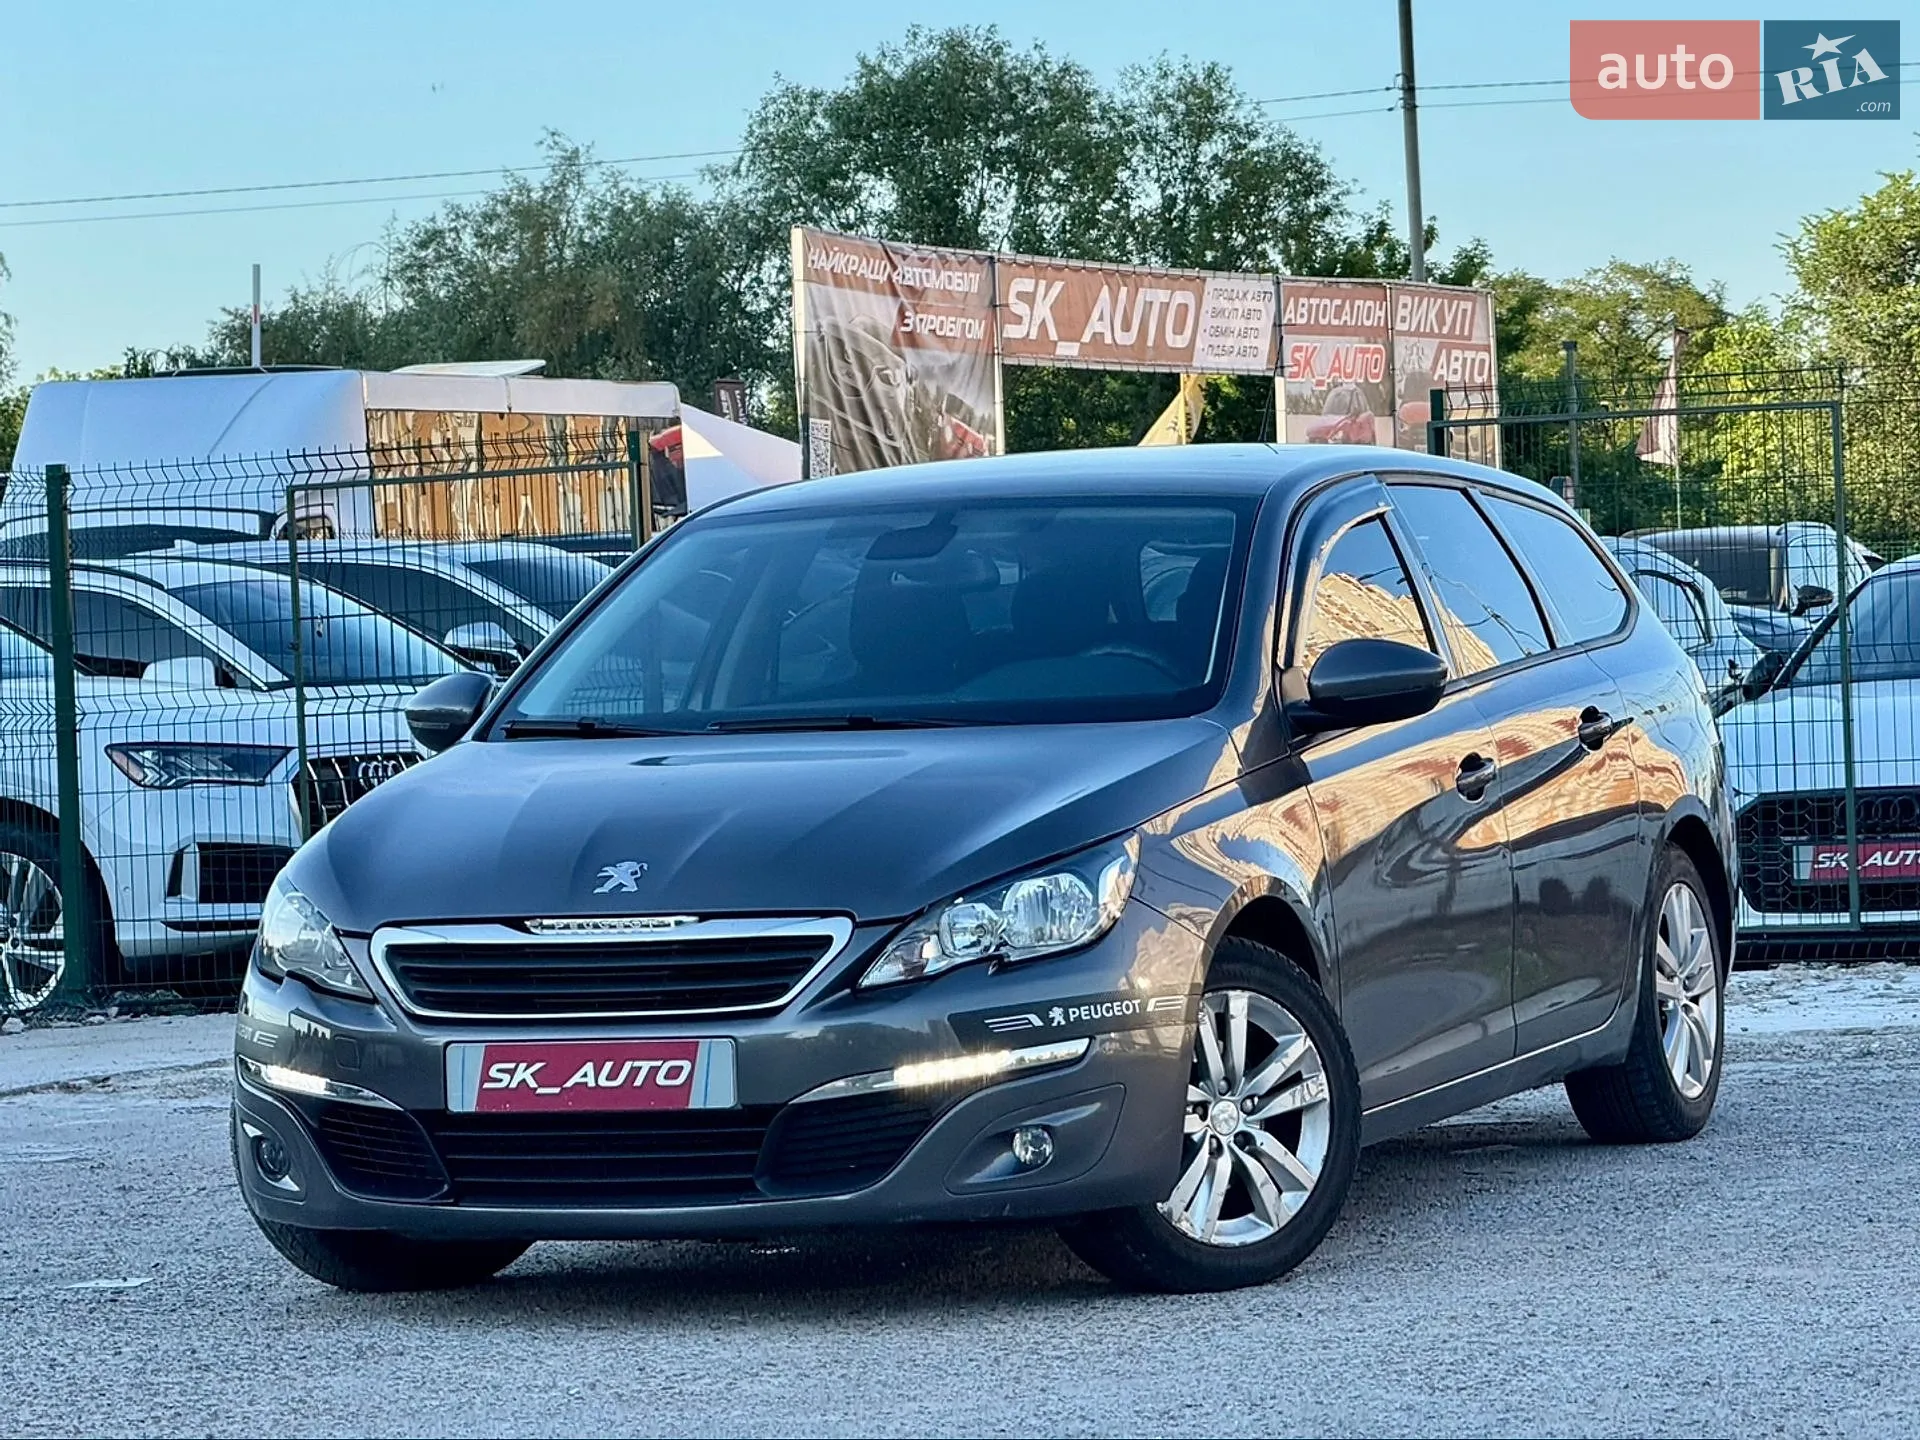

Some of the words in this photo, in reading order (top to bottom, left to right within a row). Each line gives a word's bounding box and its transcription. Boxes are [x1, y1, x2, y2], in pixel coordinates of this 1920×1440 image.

[807, 246, 890, 284] НАЙКРАЩІ
[892, 265, 980, 294] АВТОМОБІЛІ
[915, 313, 986, 340] ПРОБІГОМ
[1003, 277, 1196, 356] SK_AUTO
[1240, 308, 1262, 320] АВТО
[1284, 296, 1386, 327] АВТОСАЛОН
[1395, 294, 1472, 336] ВИКУП
[1236, 327, 1260, 339] АВТО
[1235, 345, 1259, 358] АВТО
[1287, 343, 1385, 388] SK_AUTO
[1433, 348, 1489, 383] АВТО
[1814, 850, 1920, 870] SK_AUT
[1068, 1000, 1141, 1022] PEUGEOT
[482, 1059, 692, 1095] SK_AUTO
